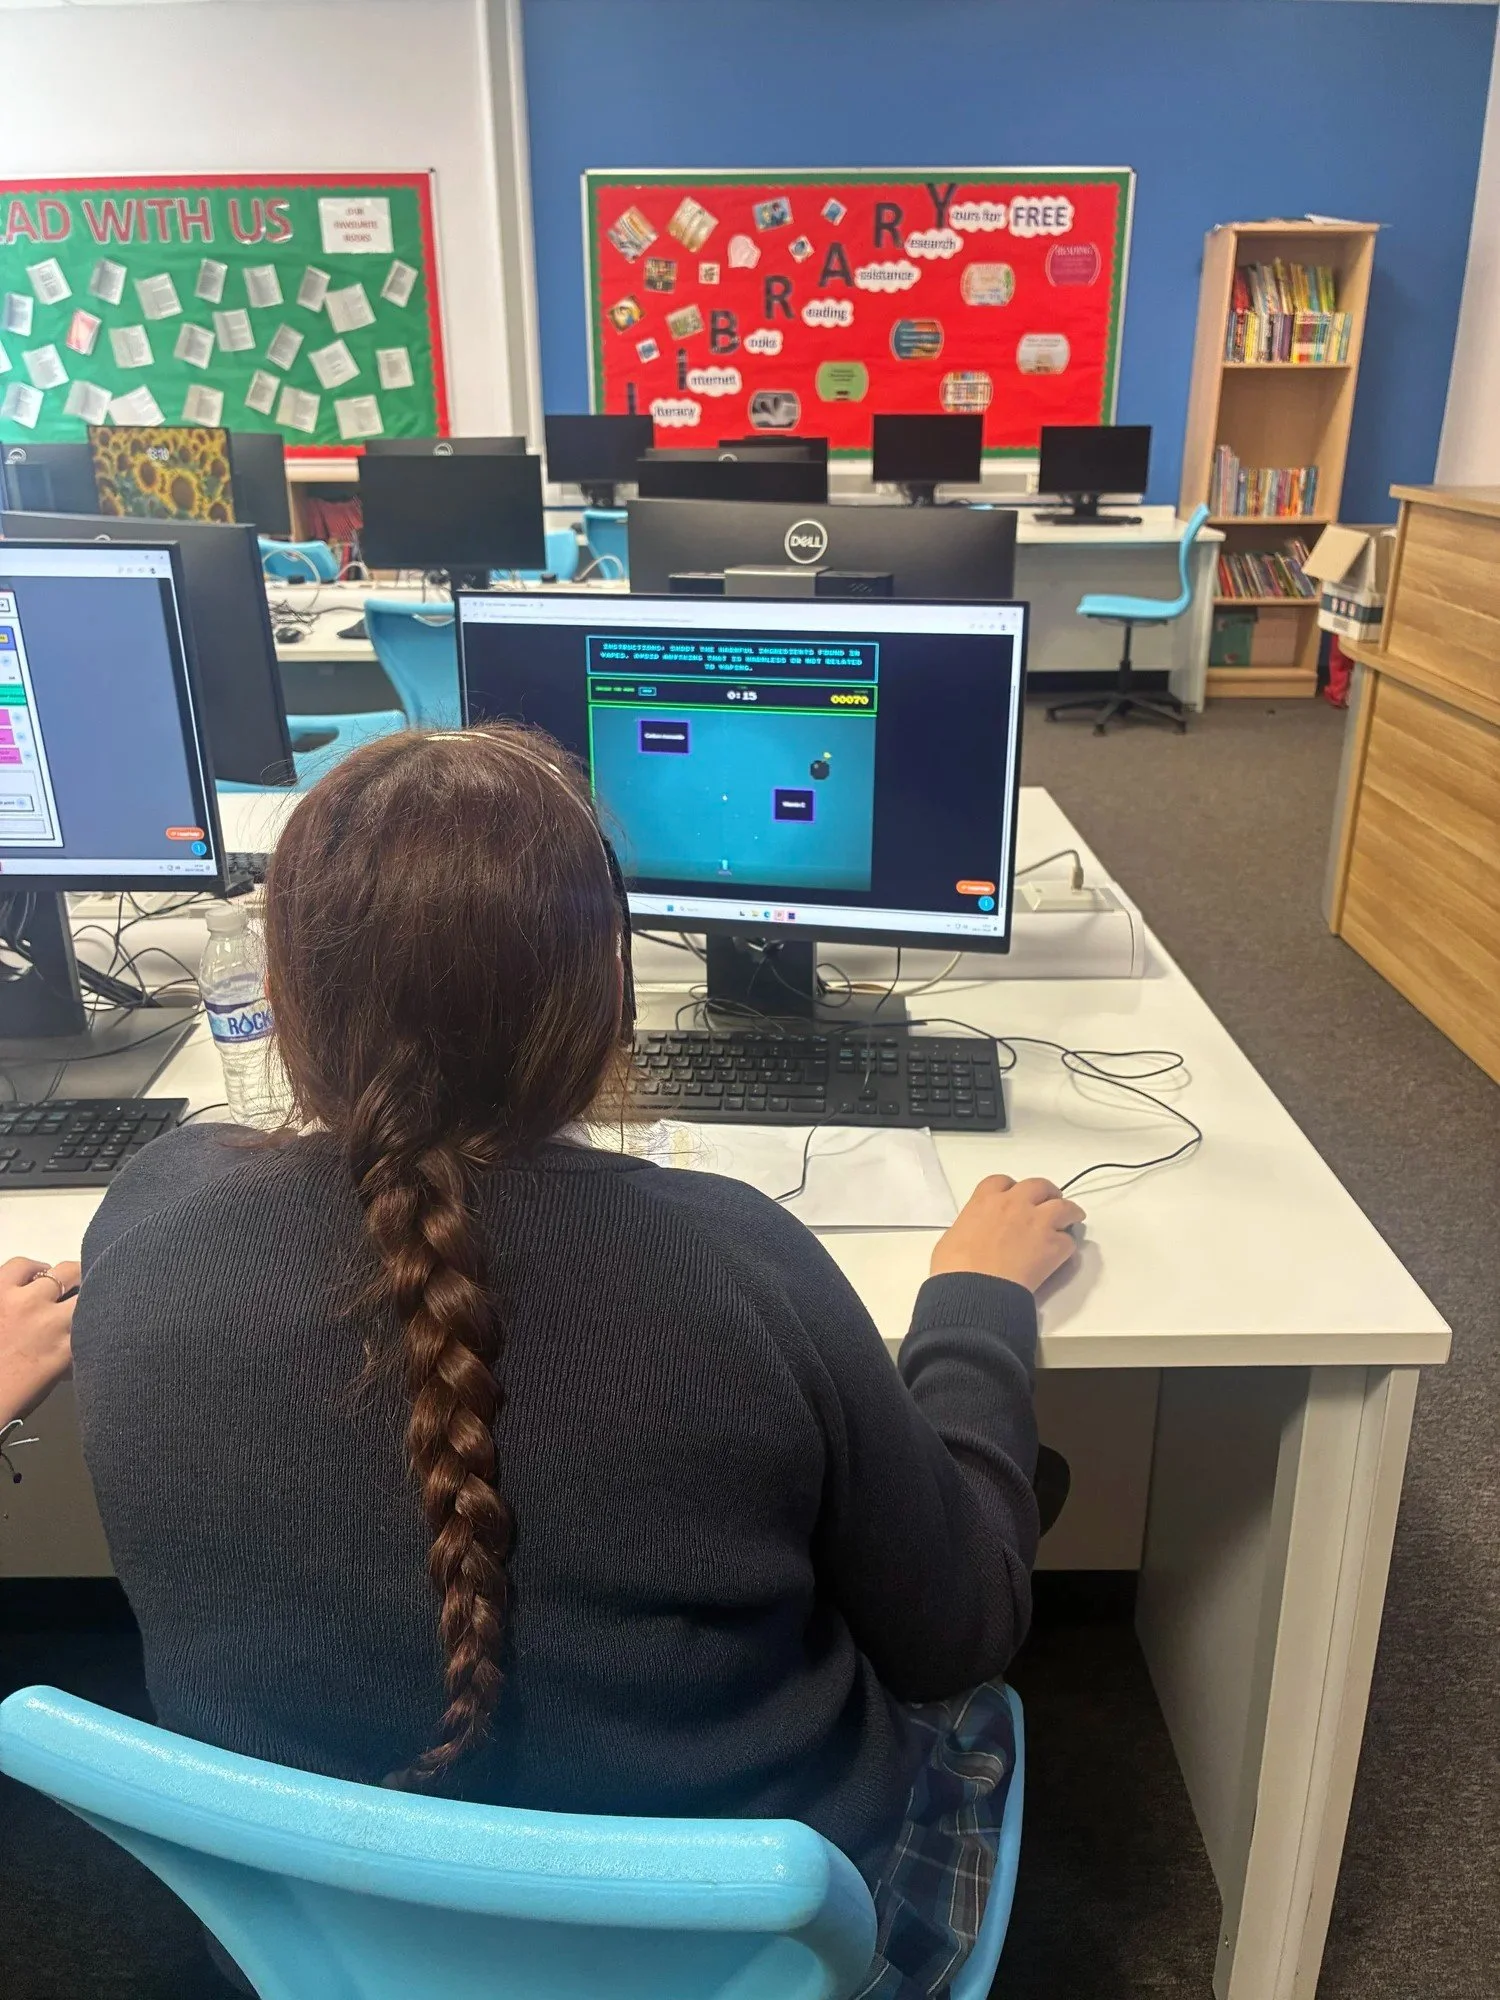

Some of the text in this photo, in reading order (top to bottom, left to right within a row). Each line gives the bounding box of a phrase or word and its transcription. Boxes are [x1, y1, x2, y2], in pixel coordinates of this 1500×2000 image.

[0, 197, 293, 244] AD WITH US
[1013, 206, 1069, 227] FREE
[790, 535, 823, 548] DELL
[727, 690, 869, 706] 0:15 00070
